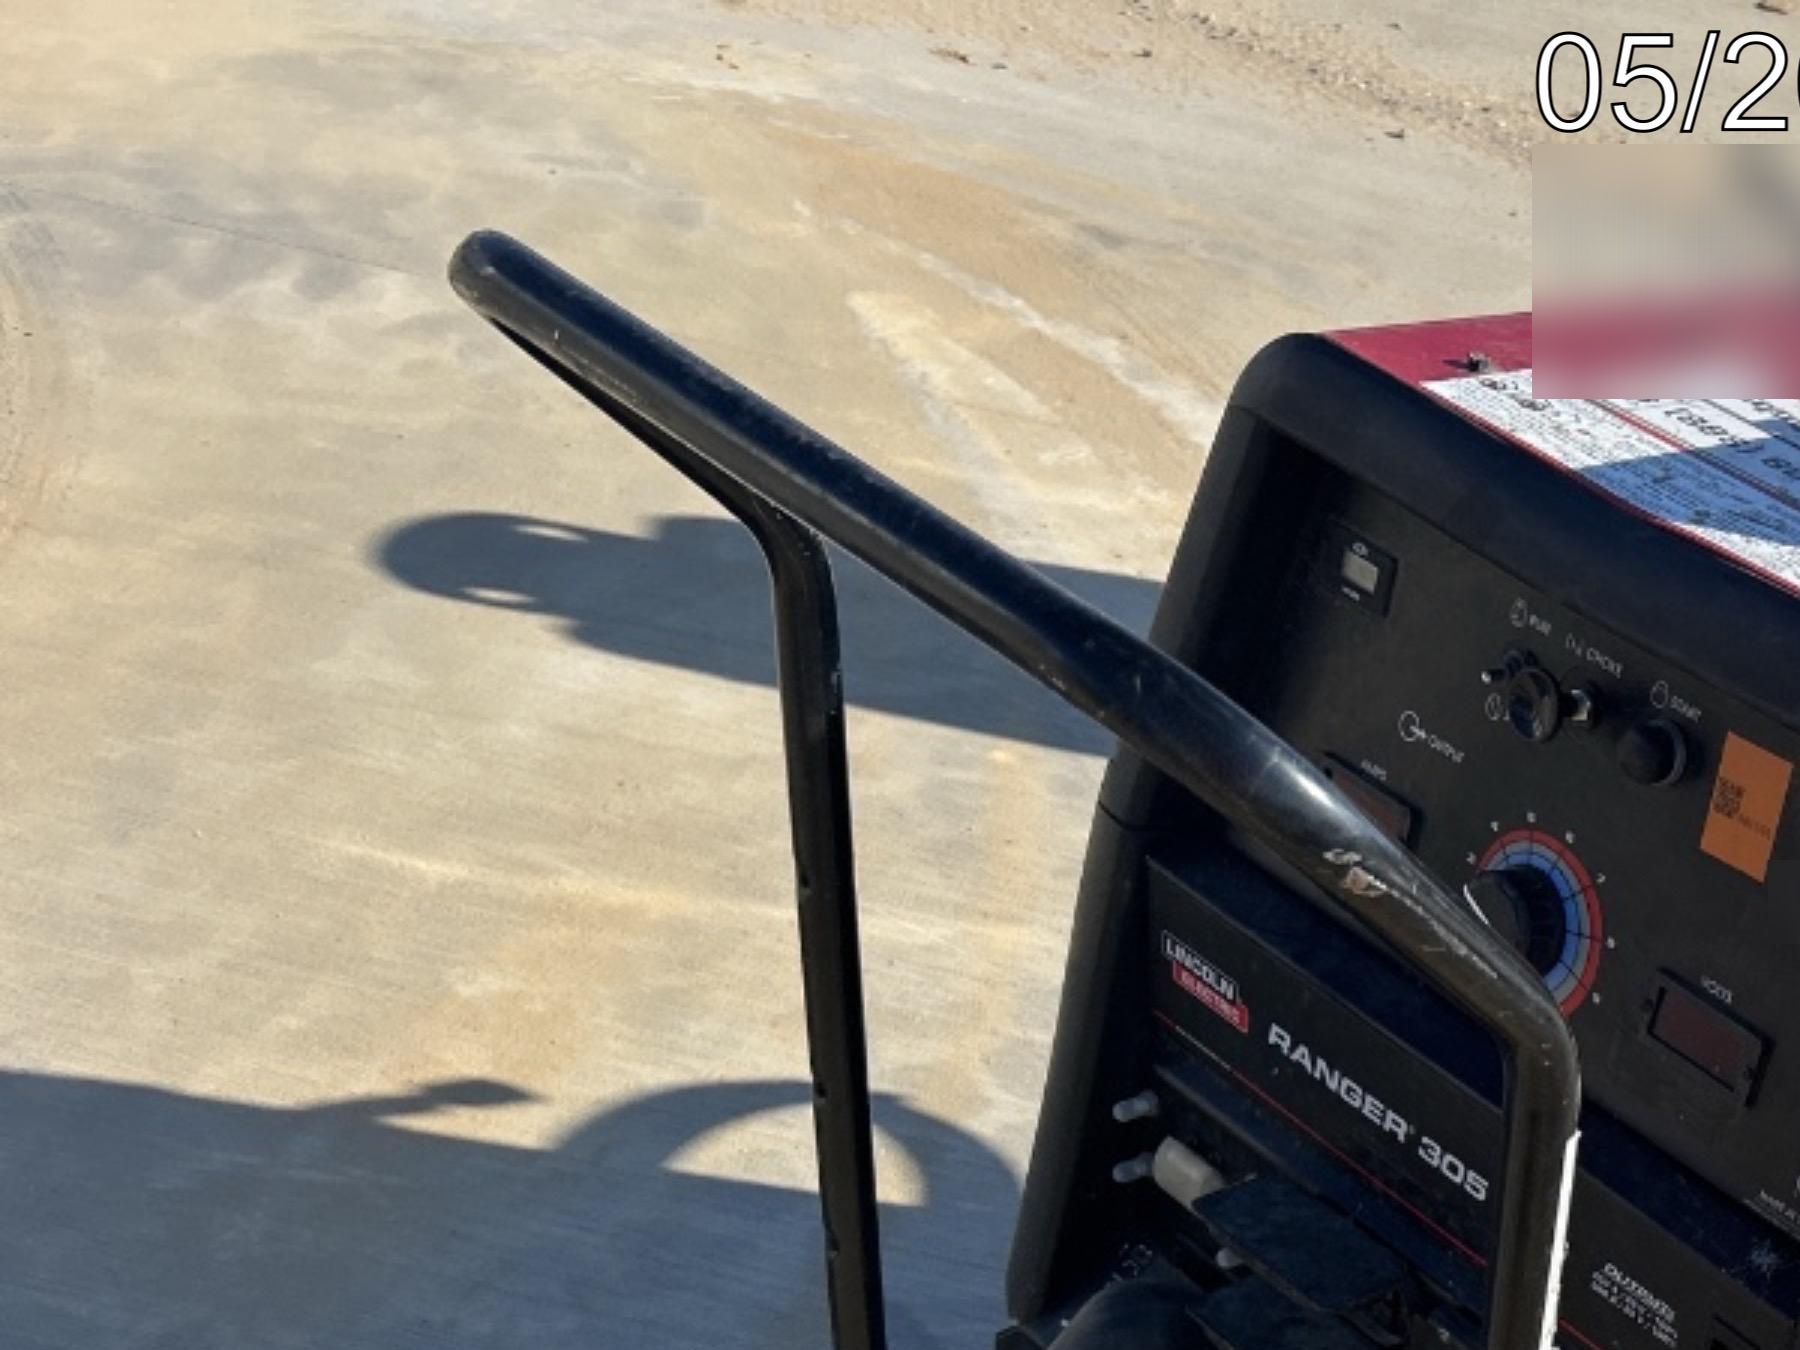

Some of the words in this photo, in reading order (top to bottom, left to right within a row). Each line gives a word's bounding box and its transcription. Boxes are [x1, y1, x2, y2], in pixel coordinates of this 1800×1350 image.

[1164, 936, 1235, 1001] LINCOLN
[1267, 1021, 1409, 1145] RANGER
[1417, 1135, 1489, 1201] 305
